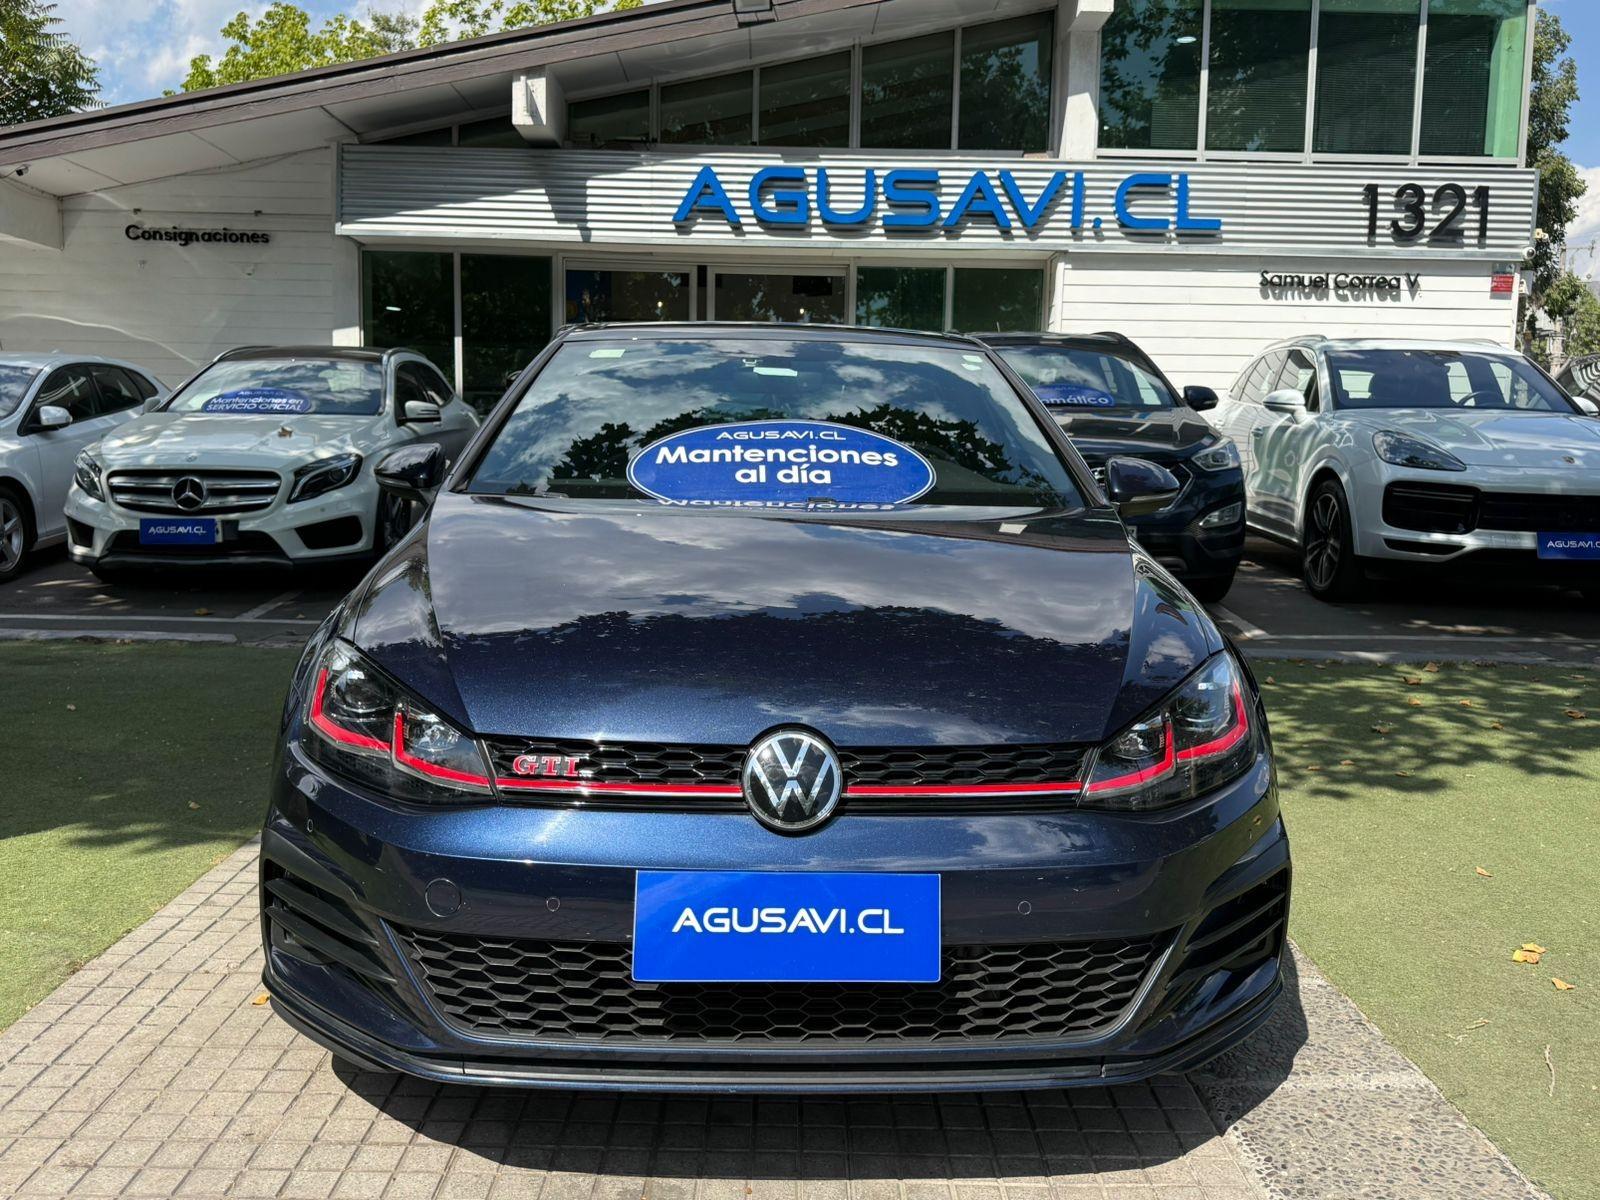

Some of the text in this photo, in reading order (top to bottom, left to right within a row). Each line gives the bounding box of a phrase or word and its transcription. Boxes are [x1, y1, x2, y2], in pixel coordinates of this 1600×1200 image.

[672, 165, 1221, 231] AGUSAVI.CL
[1362, 183, 1490, 239] 1321
[125, 224, 270, 246] Consignaciones
[1259, 270, 1329, 288] Samuel
[1334, 272, 1400, 289] Correa
[206, 403, 257, 411] SERVICIO
[716, 430, 847, 440] AGUSAVI.CL
[655, 444, 899, 467] Mantenciones
[734, 463, 832, 484] al día
[148, 526, 207, 534] AGUSAVI.CL
[512, 754, 580, 778] GTI
[671, 907, 905, 934] AGUSAVI.CL
